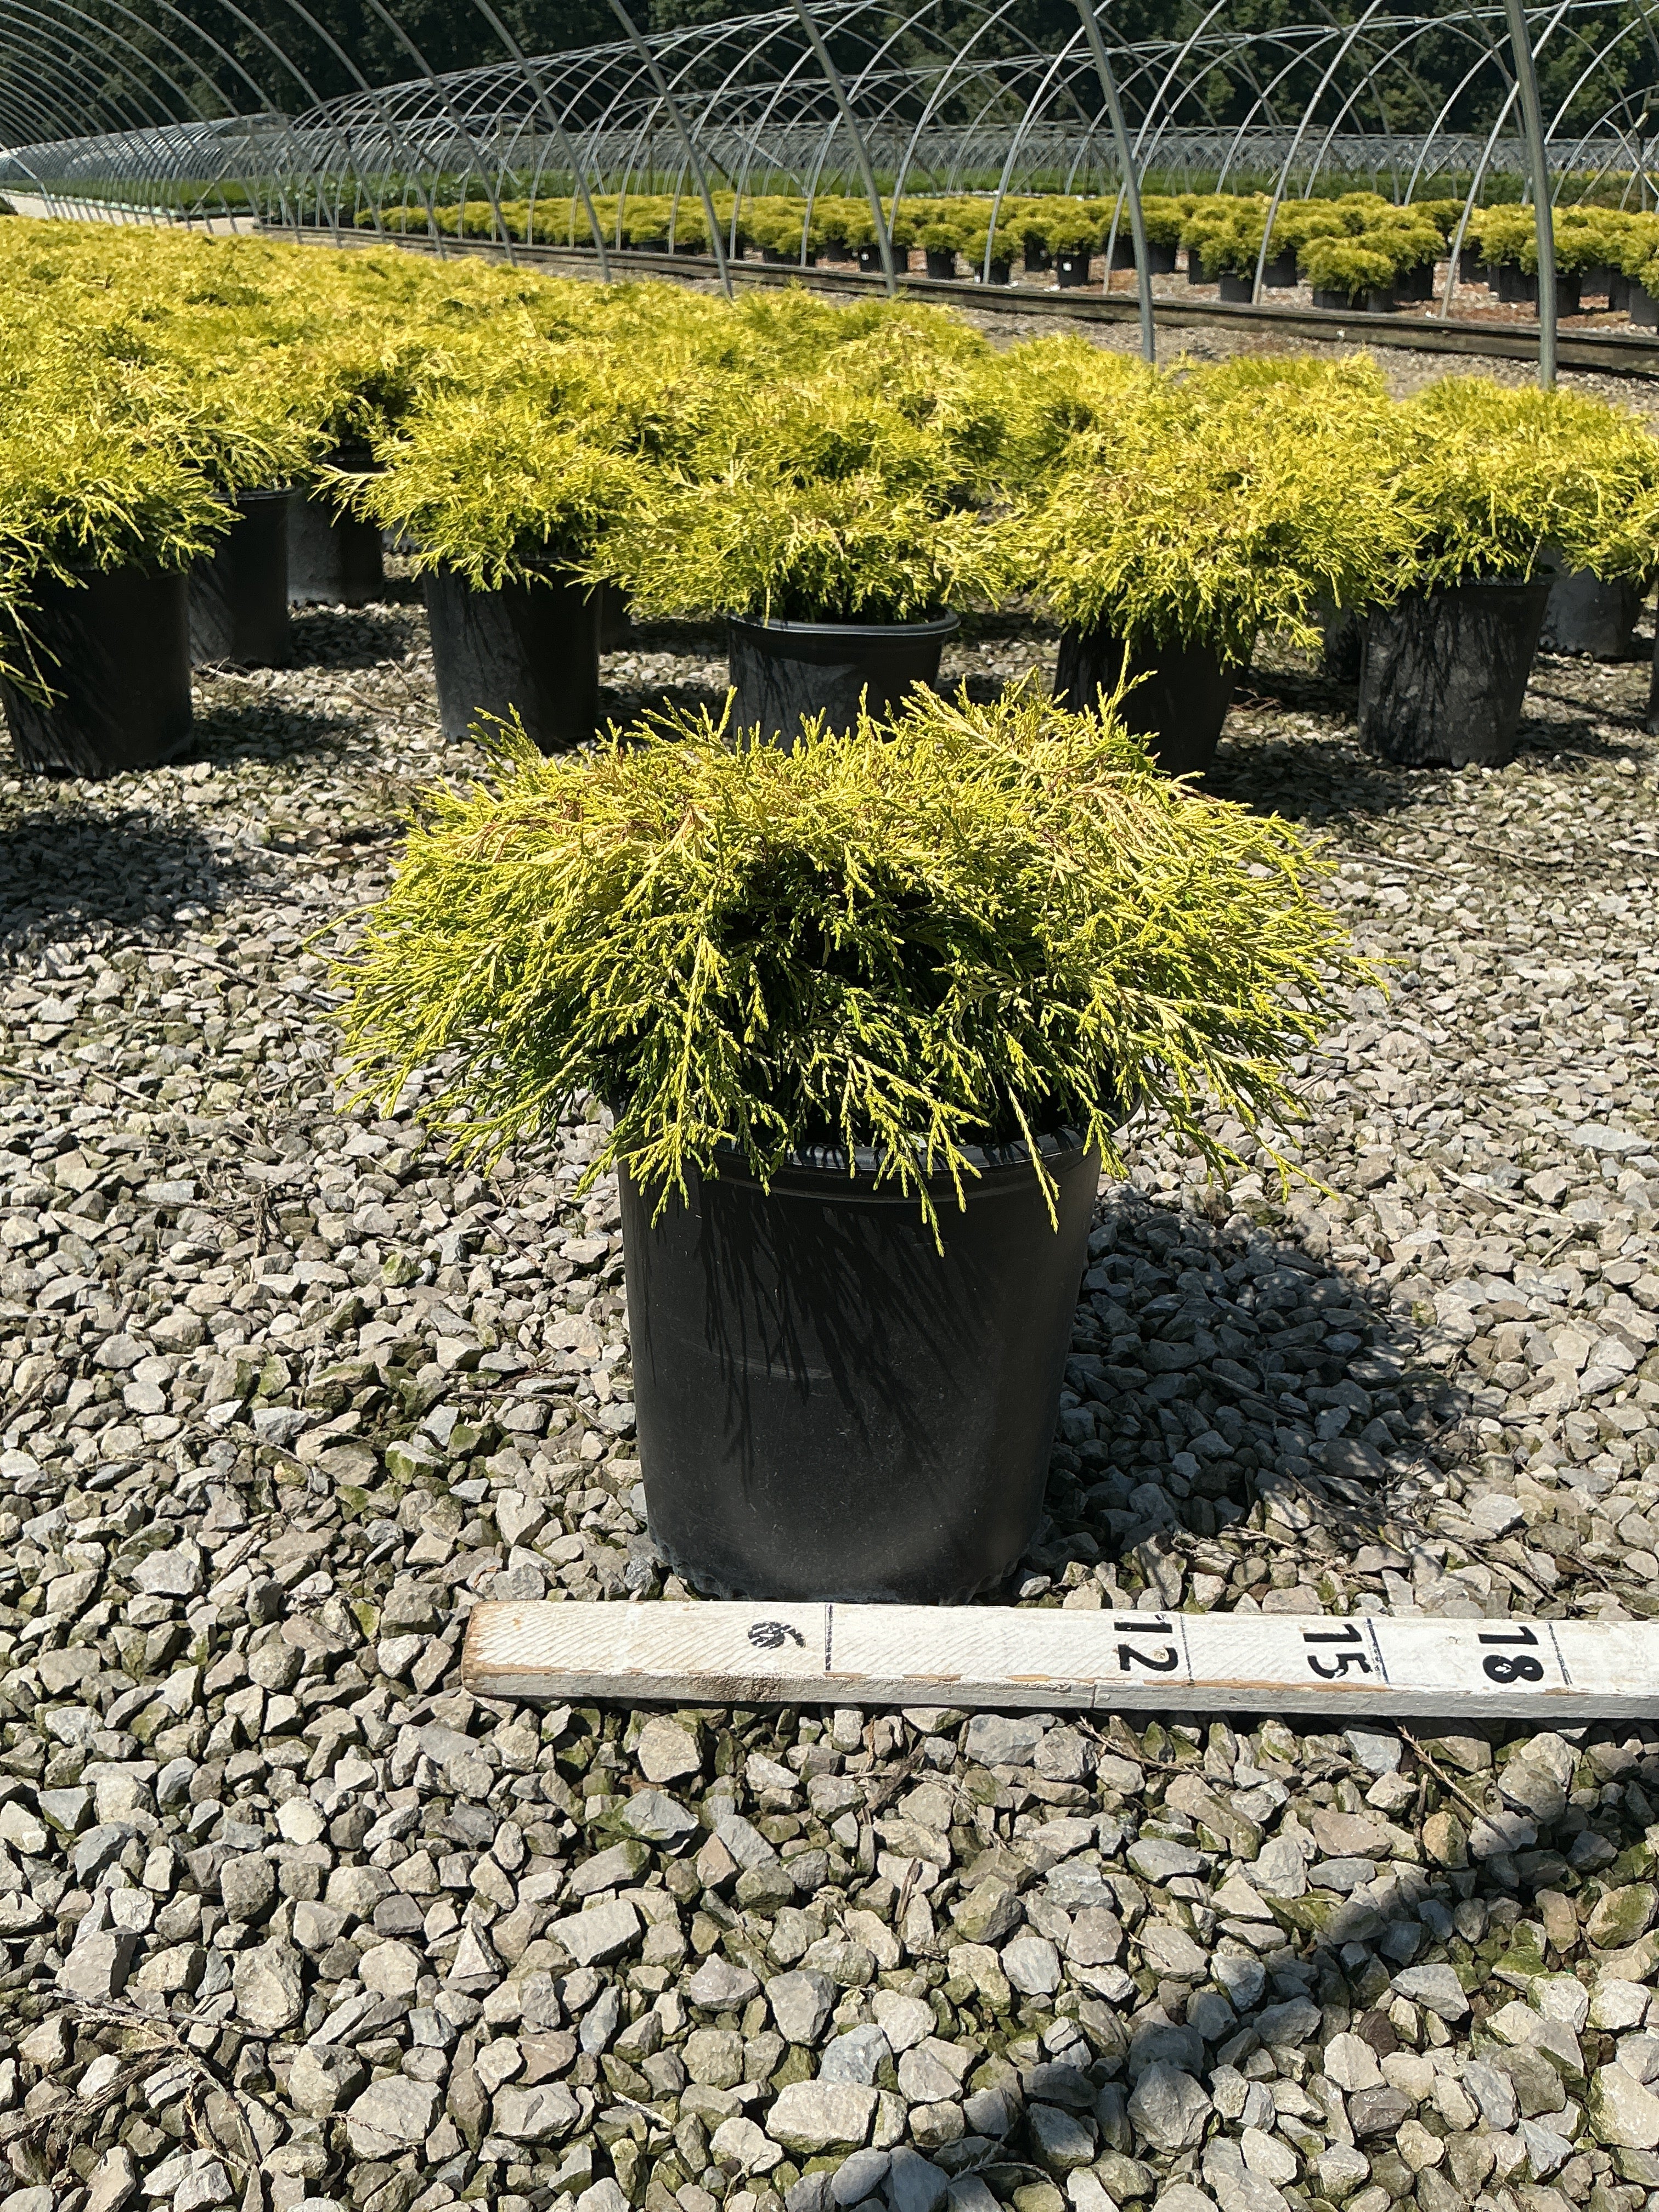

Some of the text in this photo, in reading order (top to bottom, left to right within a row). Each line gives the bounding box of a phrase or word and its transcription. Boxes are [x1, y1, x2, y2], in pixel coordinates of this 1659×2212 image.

[748, 1621, 806, 1649] 6
[1114, 1614, 1179, 1672] 12
[1303, 1623, 1373, 1678] 15
[1478, 1626, 1544, 1683] 18
